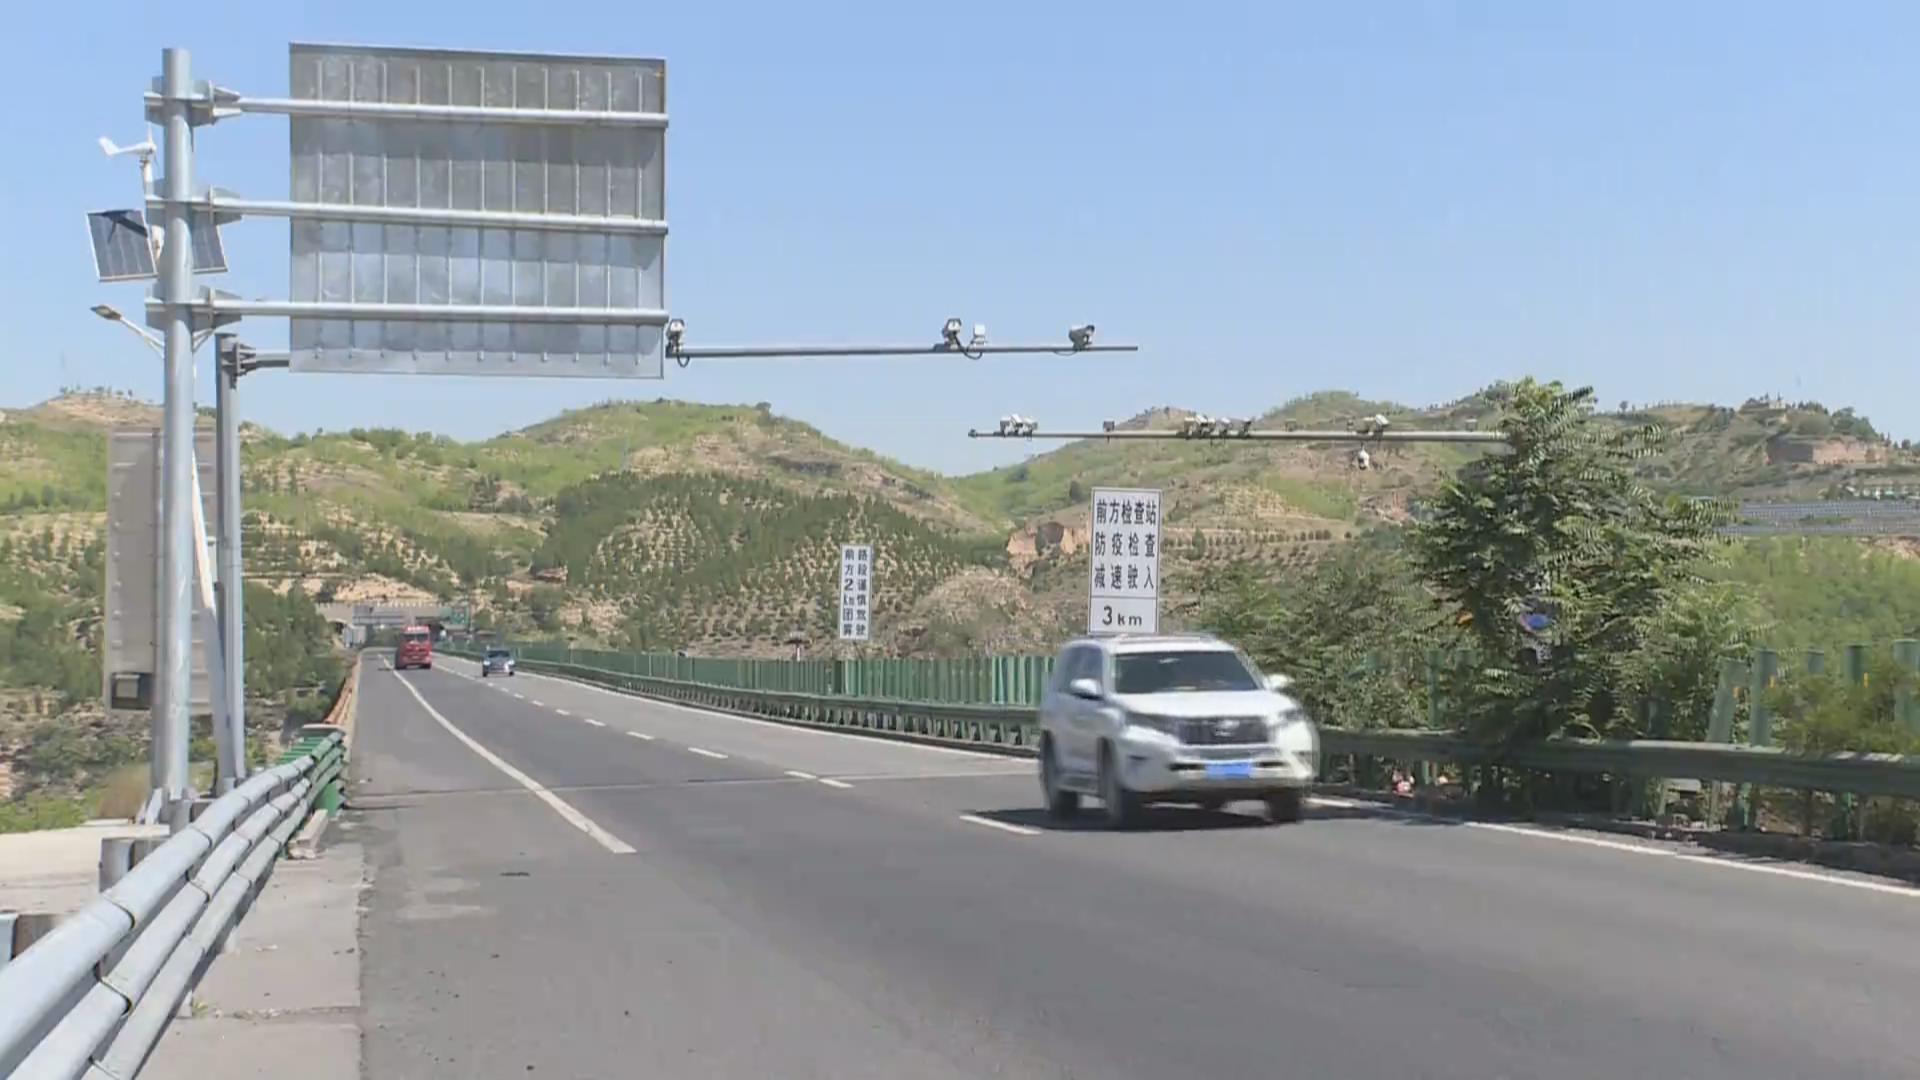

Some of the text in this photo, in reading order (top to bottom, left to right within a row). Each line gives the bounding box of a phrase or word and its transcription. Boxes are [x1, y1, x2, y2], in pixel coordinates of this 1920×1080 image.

[1096, 499, 1157, 526] 前方检查站
[1094, 531, 1156, 558] 防疫检查
[1094, 564, 1154, 590] 减速驶入
